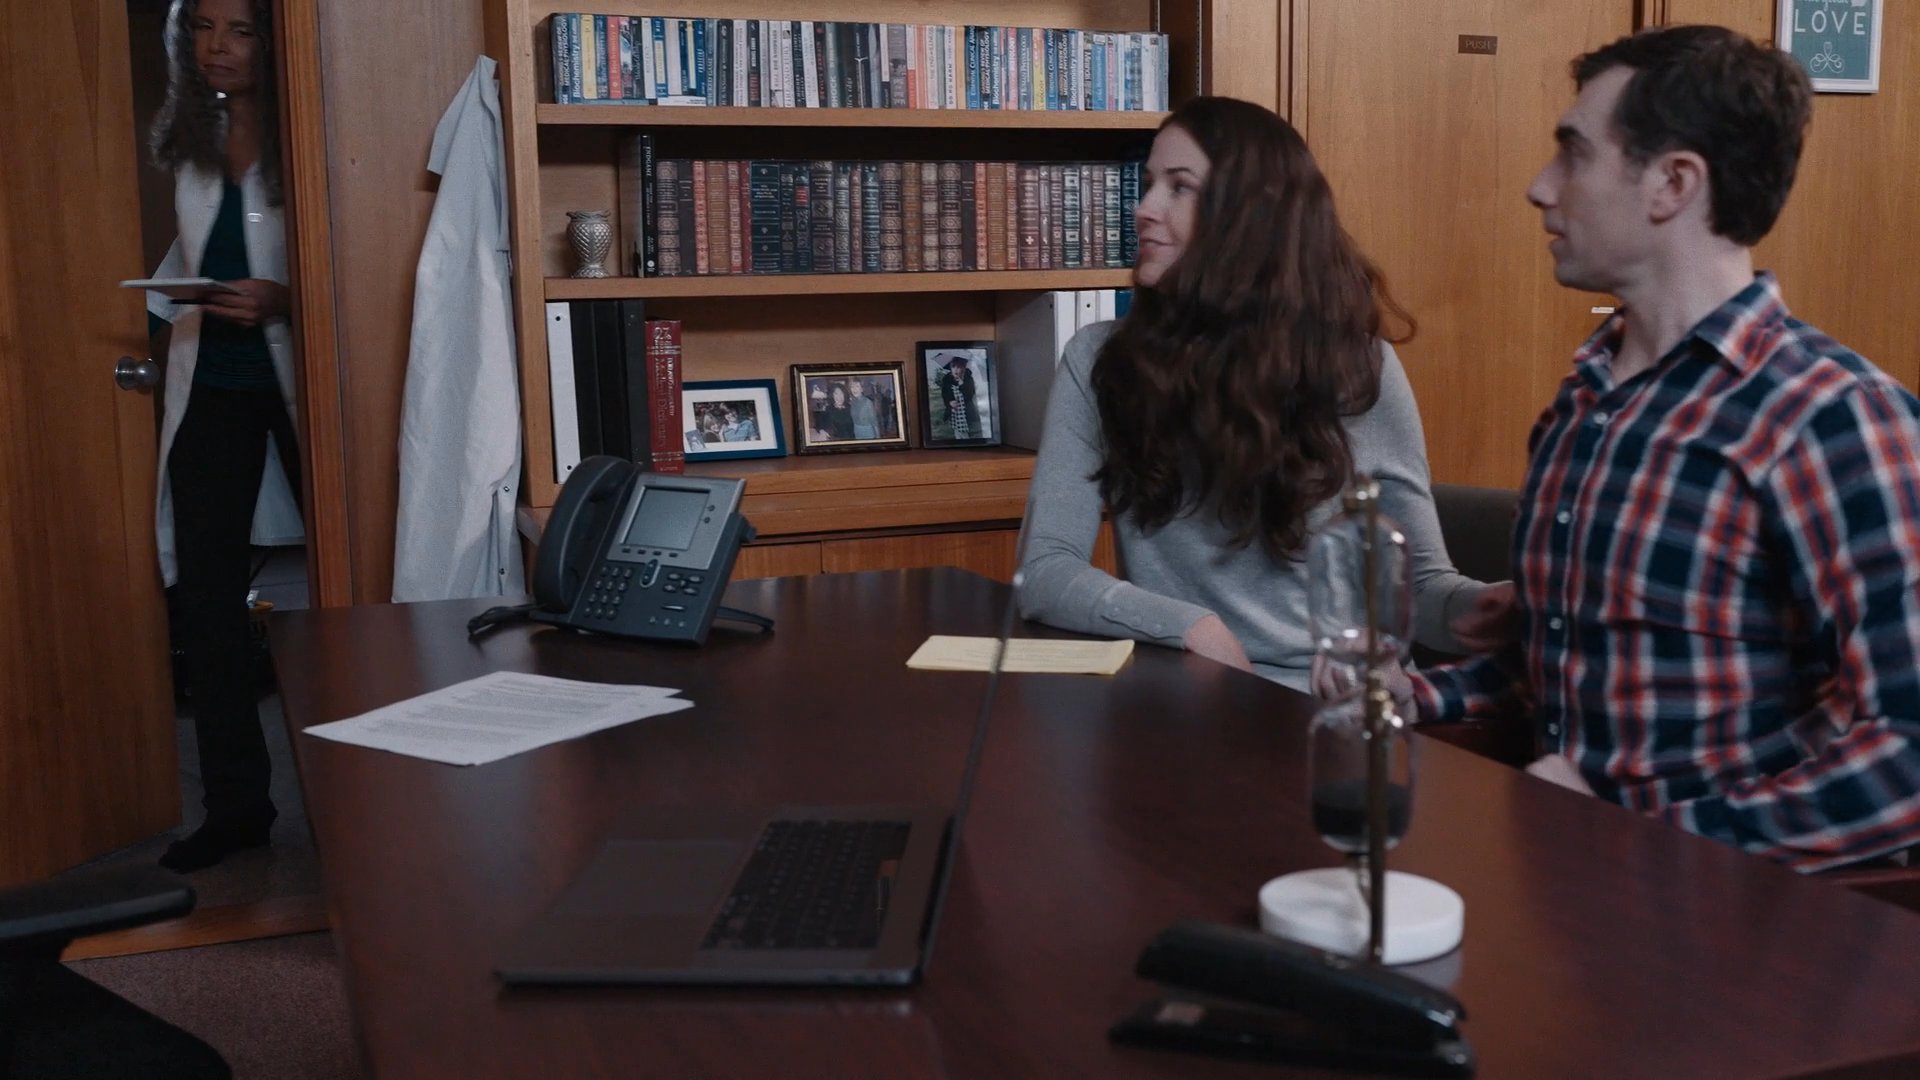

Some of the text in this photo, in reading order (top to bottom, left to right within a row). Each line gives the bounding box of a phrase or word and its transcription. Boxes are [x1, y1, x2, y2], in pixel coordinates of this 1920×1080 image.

[1794, 9, 1866, 35] LOVE
[1465, 40, 1490, 50] PUSH
[572, 45, 581, 97] Biochemistry
[992, 56, 1000, 104] Biochemistry
[644, 146, 652, 176] ENDGAME
